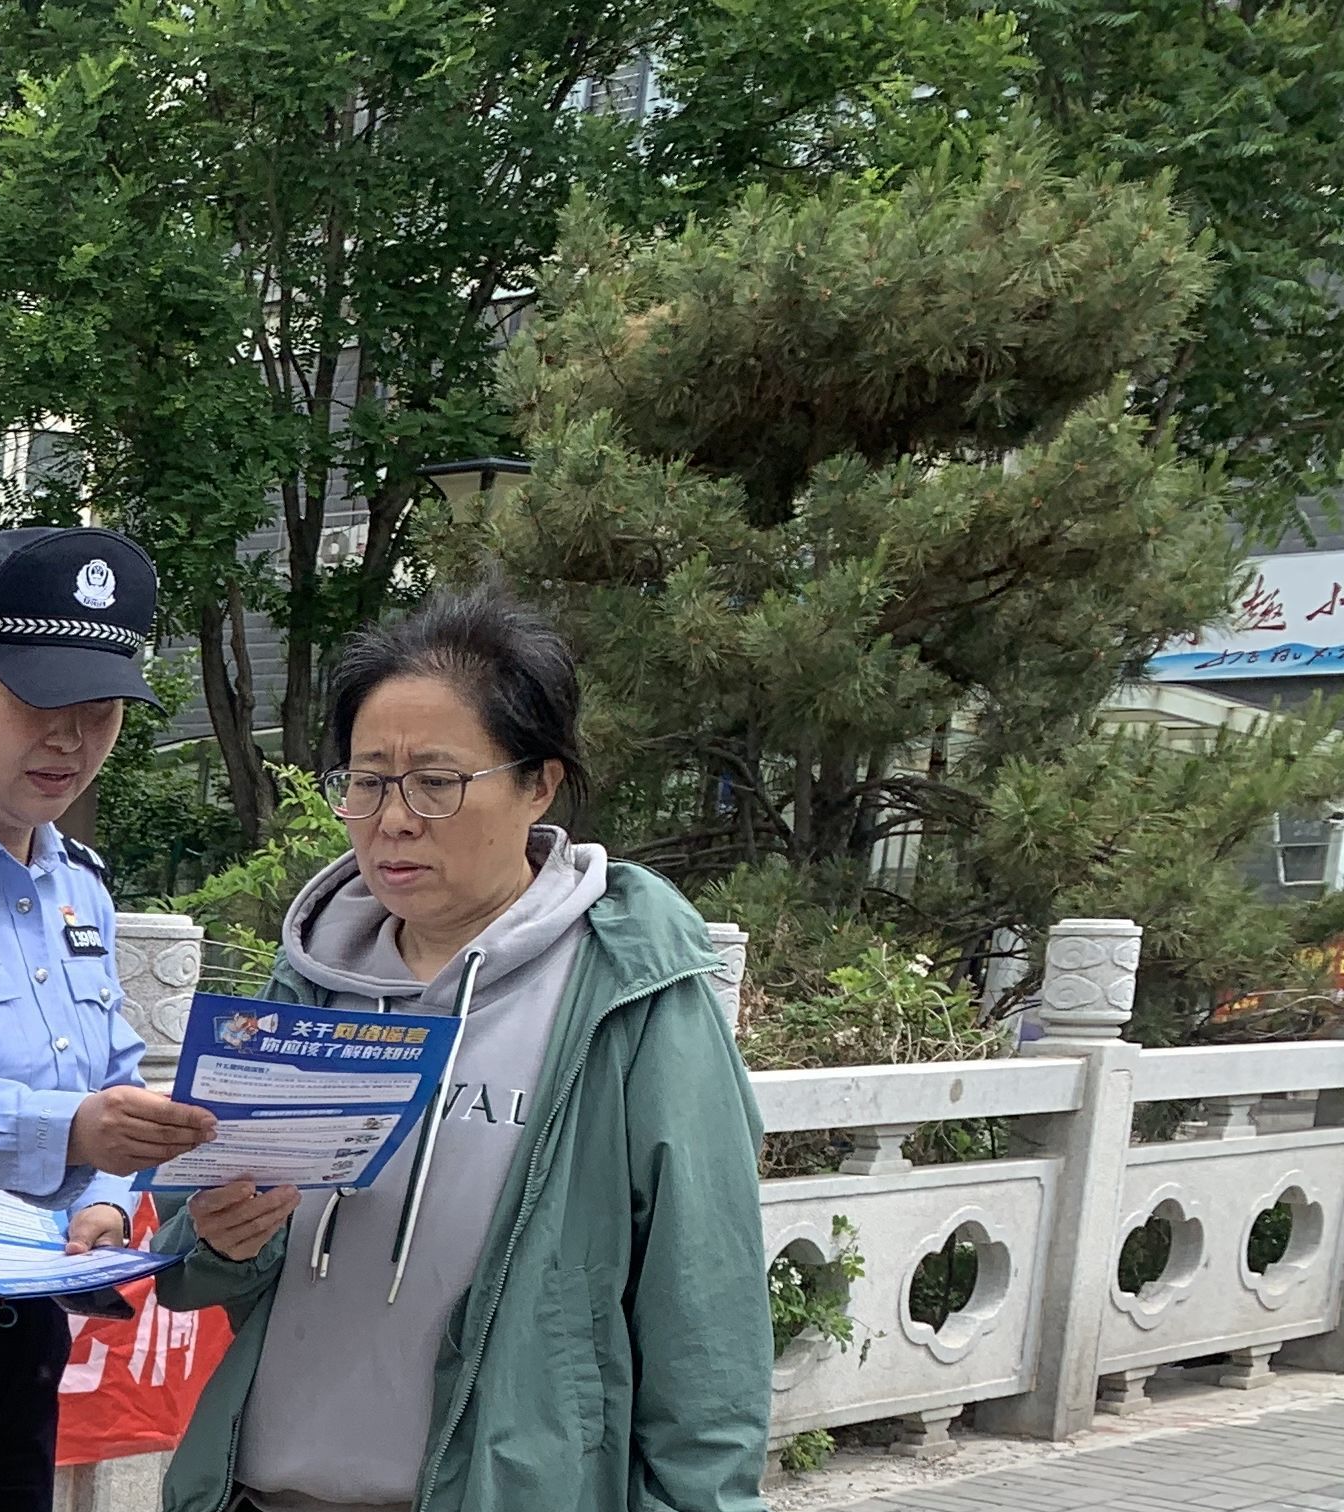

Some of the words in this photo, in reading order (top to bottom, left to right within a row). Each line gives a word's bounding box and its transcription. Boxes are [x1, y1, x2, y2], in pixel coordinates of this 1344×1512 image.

[291, 1019, 431, 1044] 关于网络谣言
[259, 1036, 424, 1061] 你应该了解的知识
